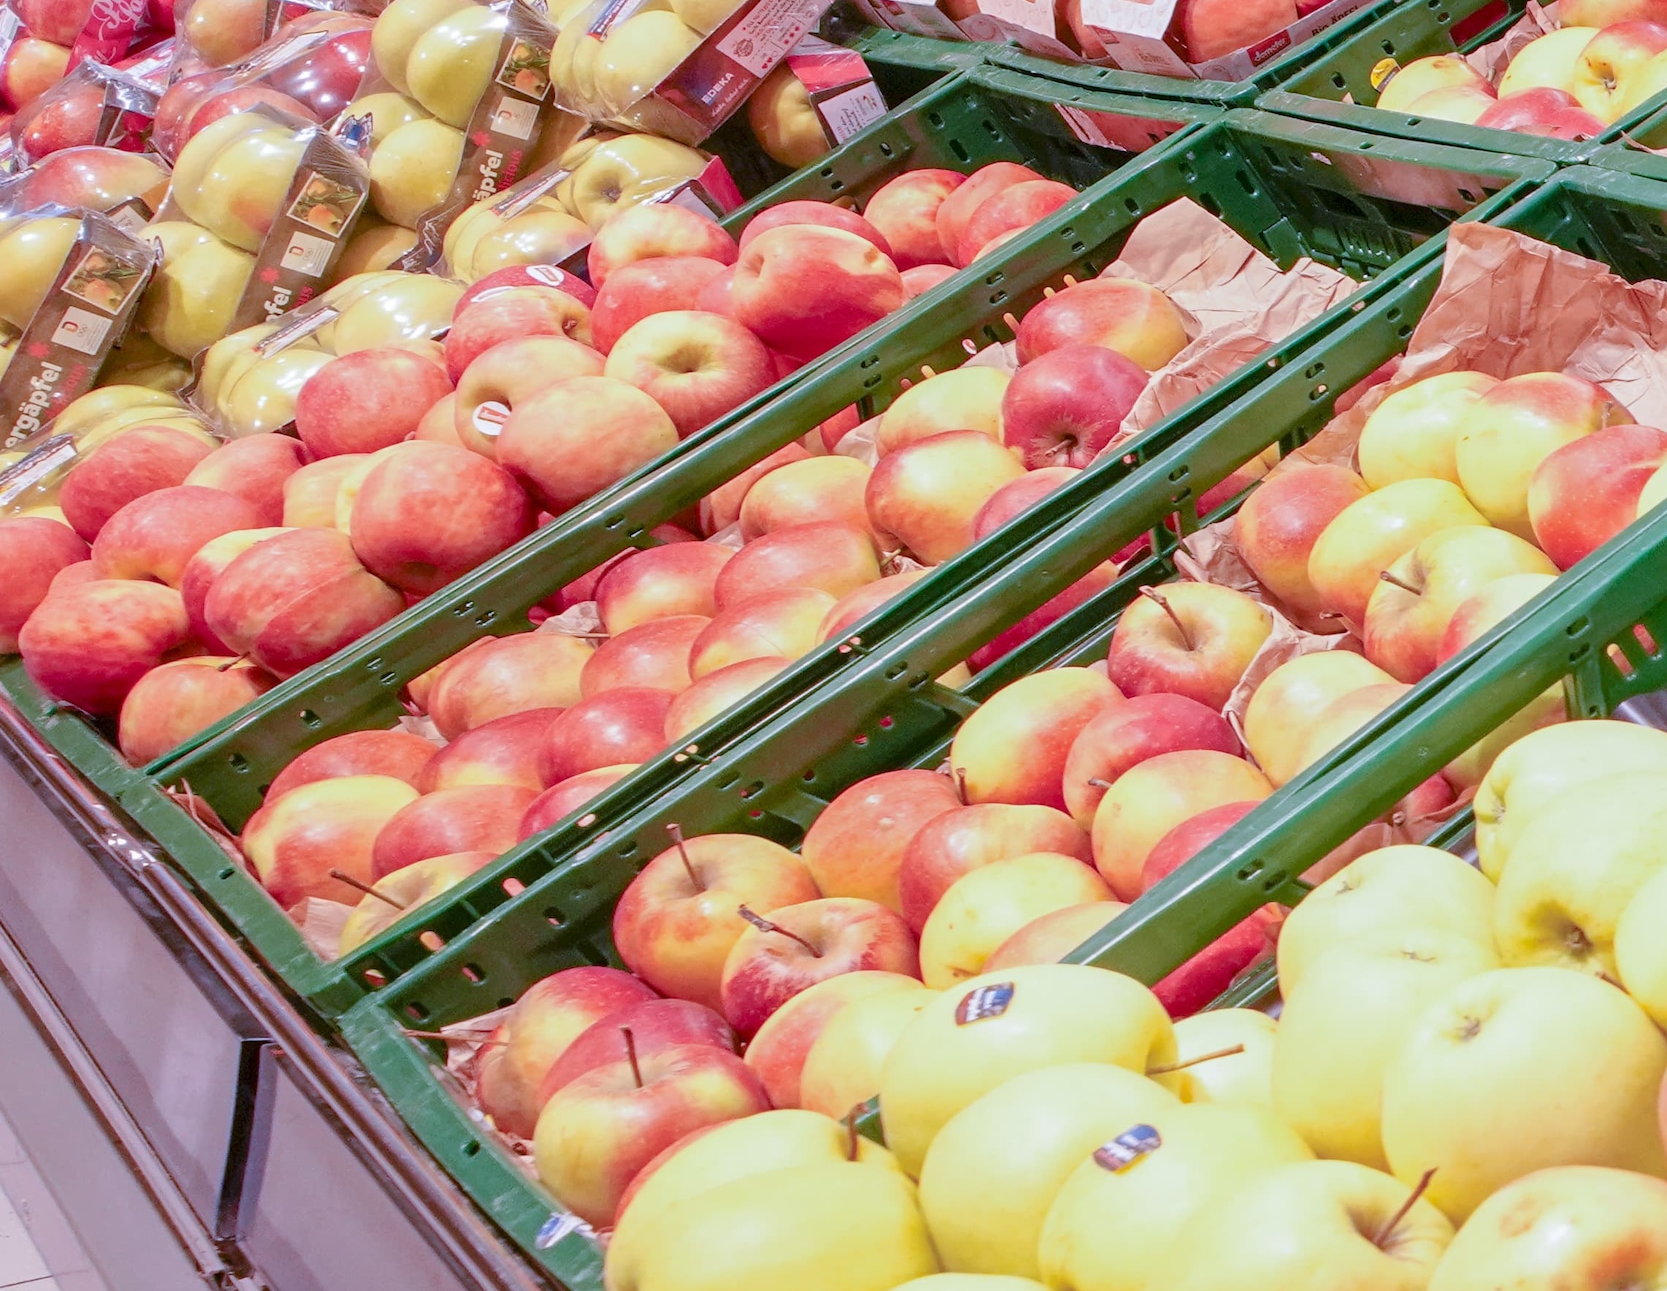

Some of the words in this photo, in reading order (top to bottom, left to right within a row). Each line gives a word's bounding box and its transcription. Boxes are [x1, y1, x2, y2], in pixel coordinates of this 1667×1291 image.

[1253, 37, 1288, 63] demeter
[700, 71, 735, 107] EDEKA
[5, 360, 64, 448] ergäpfel
